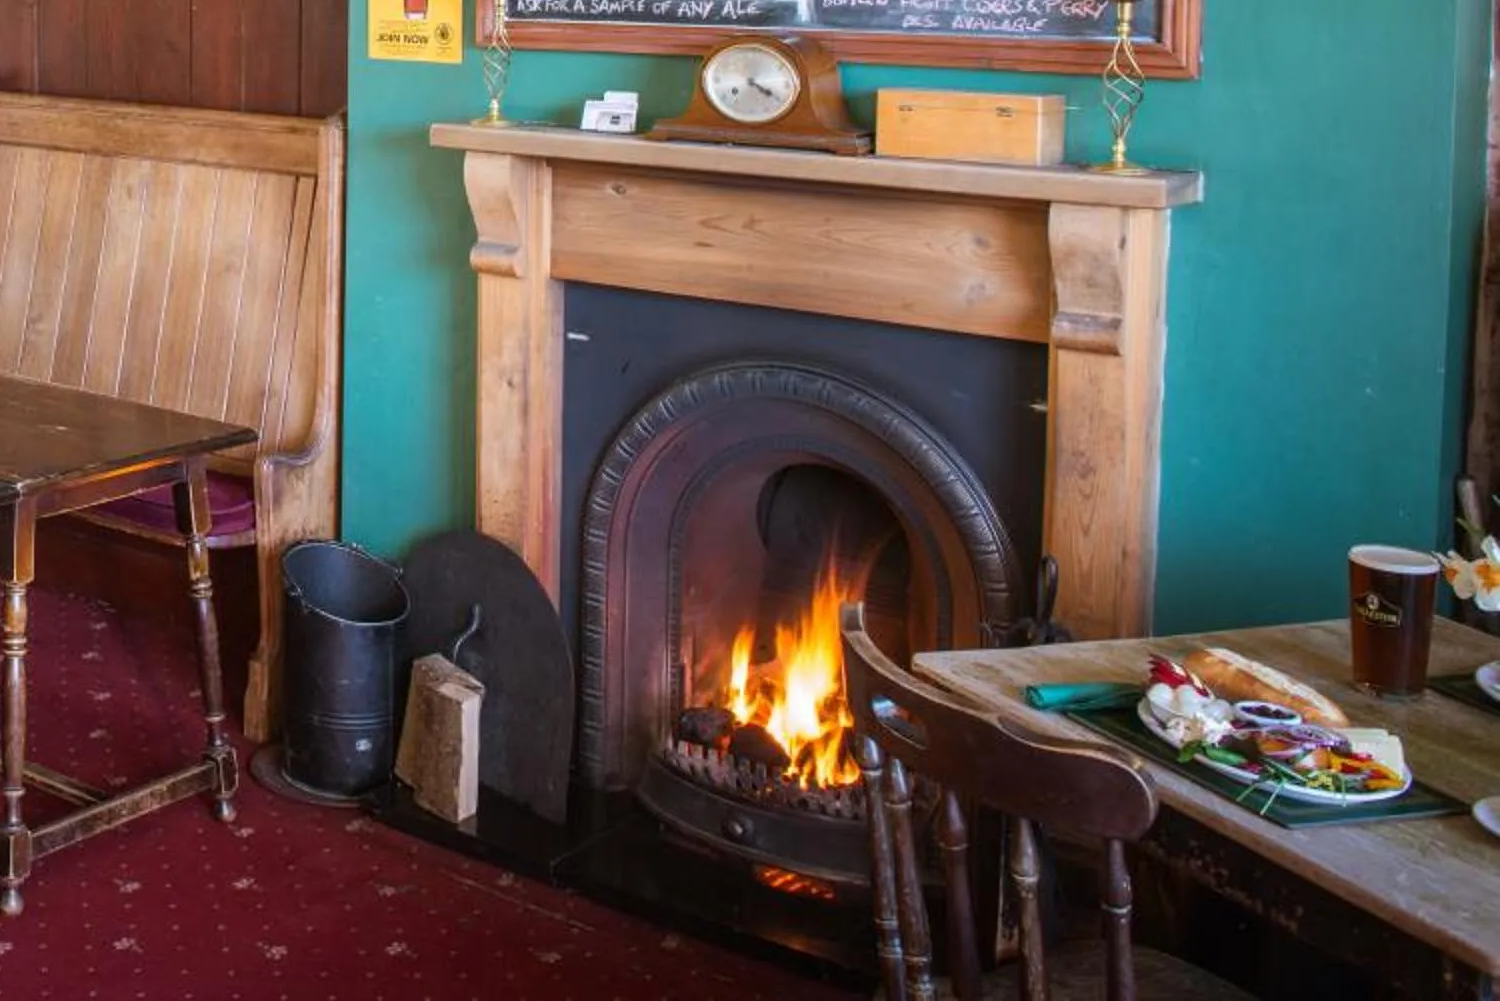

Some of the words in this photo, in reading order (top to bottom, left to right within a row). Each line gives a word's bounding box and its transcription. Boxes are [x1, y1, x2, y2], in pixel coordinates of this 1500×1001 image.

[652, 2, 672, 15] OF
[677, 0, 715, 19] ANY
[721, 0, 762, 18] ALE
